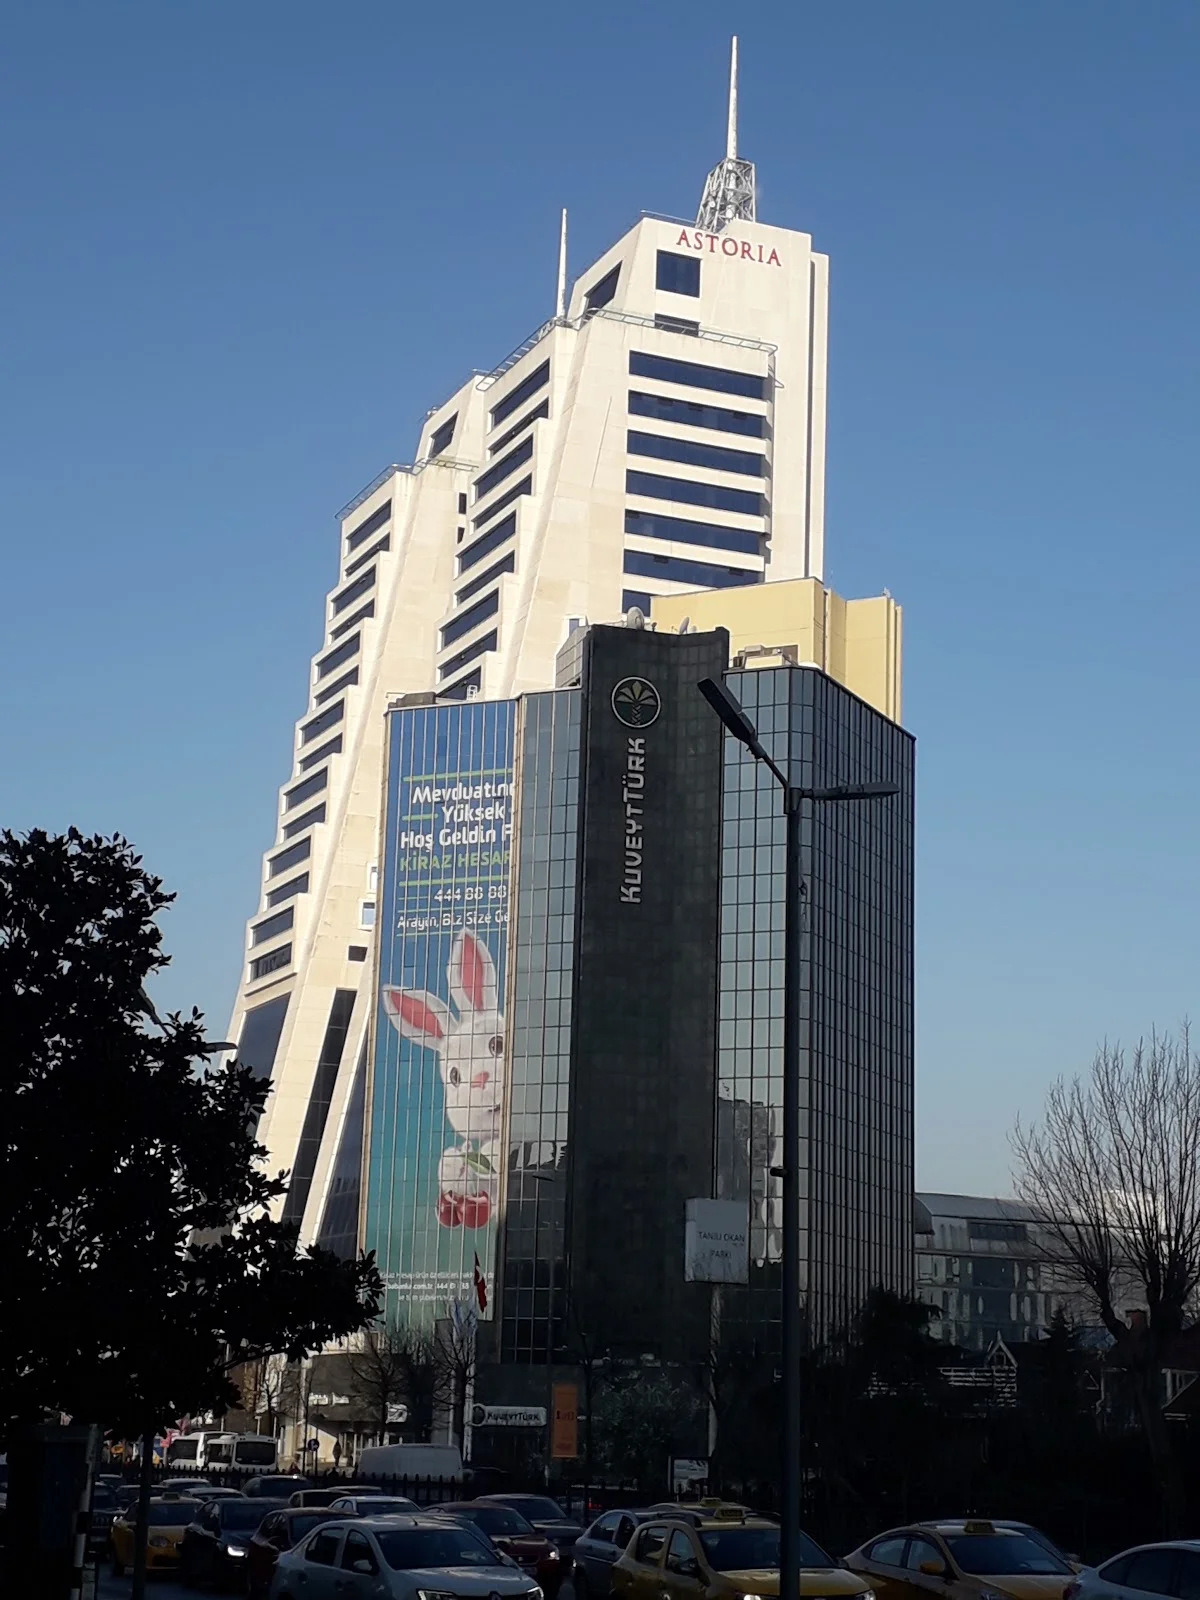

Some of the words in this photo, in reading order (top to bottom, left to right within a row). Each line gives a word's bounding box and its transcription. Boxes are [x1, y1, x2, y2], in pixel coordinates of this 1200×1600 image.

[676, 229, 782, 267] ASTORIA
[441, 801, 506, 823] Yüksek
[400, 830, 433, 852] Hoş
[439, 825, 496, 847] Geldin
[400, 851, 453, 872] KİRAZ
[434, 888, 462, 901] 444
[465, 887, 484, 900] 88
[488, 885, 507, 899] 88
[466, 910, 492, 925] Size
